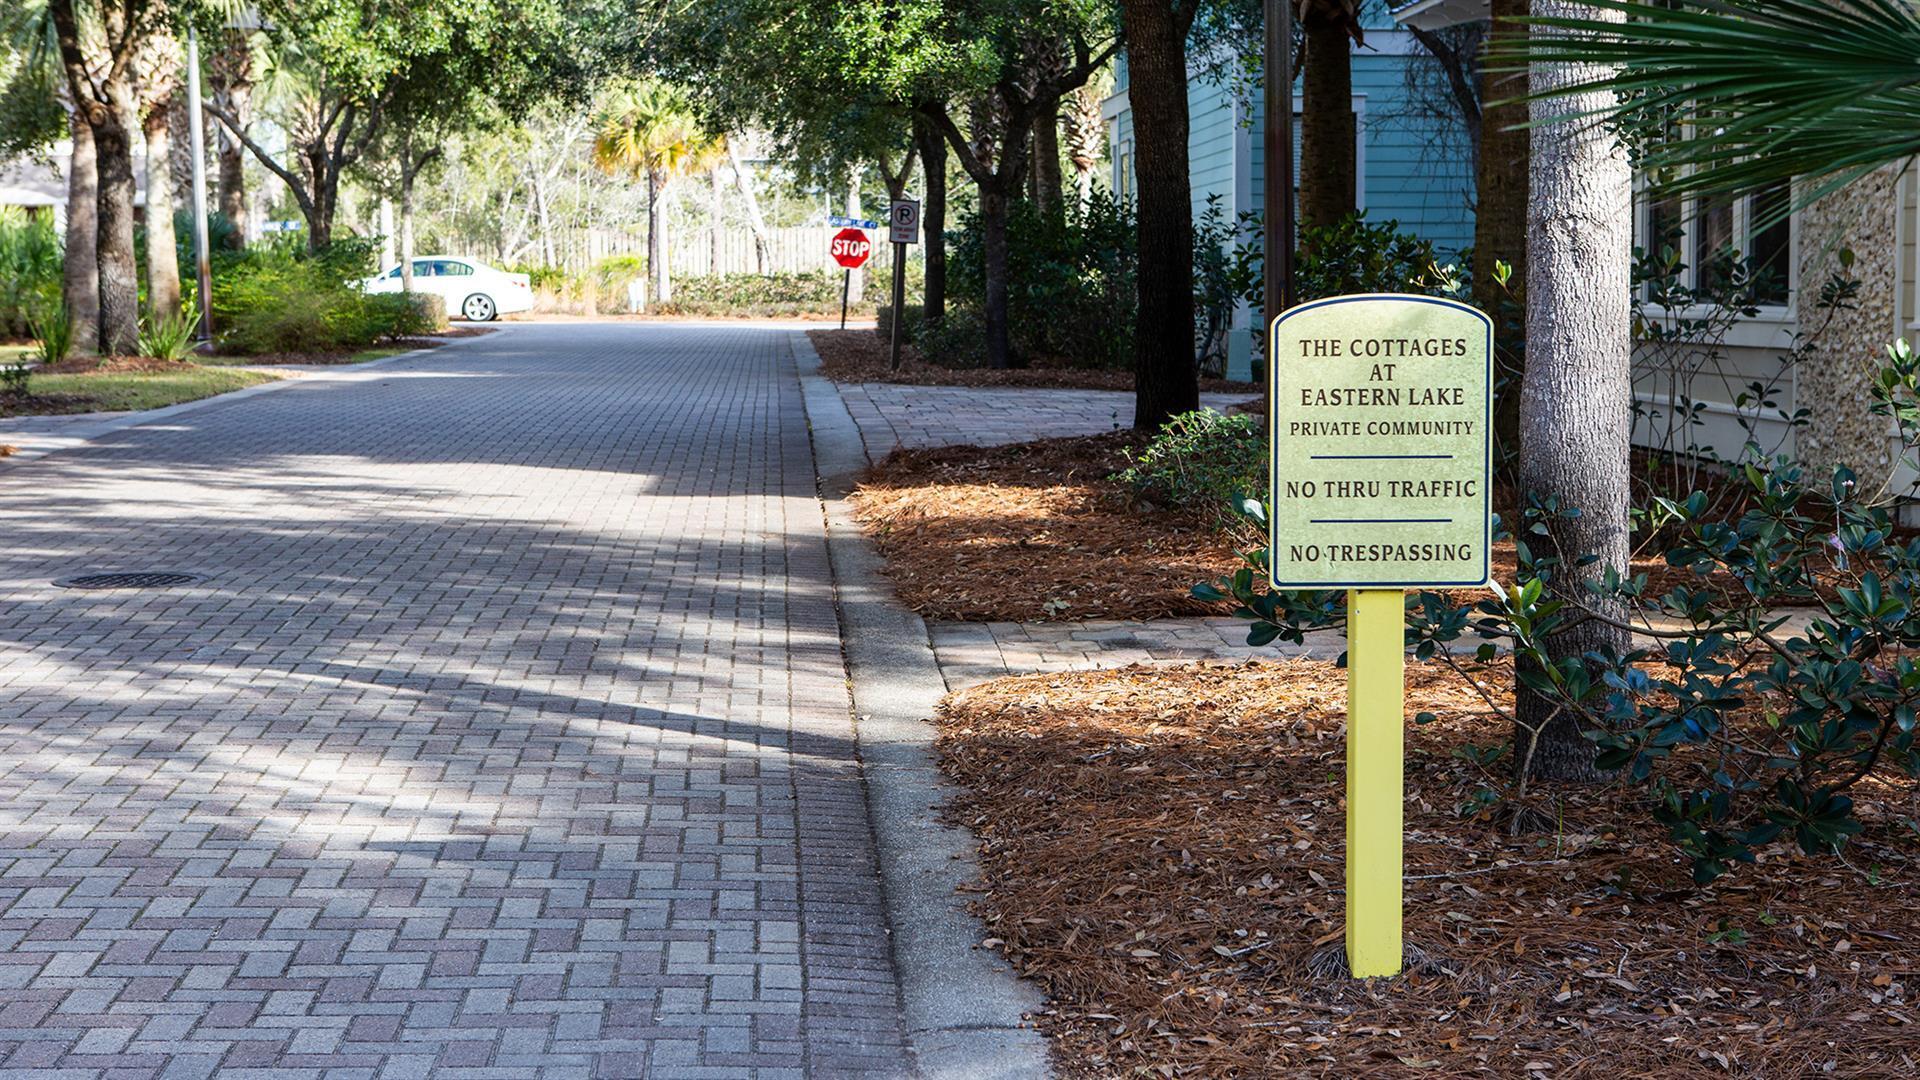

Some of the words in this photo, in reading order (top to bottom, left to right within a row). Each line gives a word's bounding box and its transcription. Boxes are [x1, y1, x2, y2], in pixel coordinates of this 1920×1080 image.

[832, 239, 870, 257] STOP
[1299, 339, 1342, 357] THE
[1350, 338, 1467, 357] COTTAGES
[1369, 364, 1397, 381] AT
[1301, 388, 1401, 406] EASTERN
[1408, 388, 1465, 406] LAKE
[1290, 421, 1361, 436] PRIVATE
[1367, 421, 1474, 436] COMMUNITY
[1286, 481, 1316, 498] NO
[1323, 481, 1380, 498] THRU
[1387, 480, 1476, 498] TRAFFIC
[1290, 545, 1320, 562] NO
[1327, 544, 1473, 562] TRESPASSING
